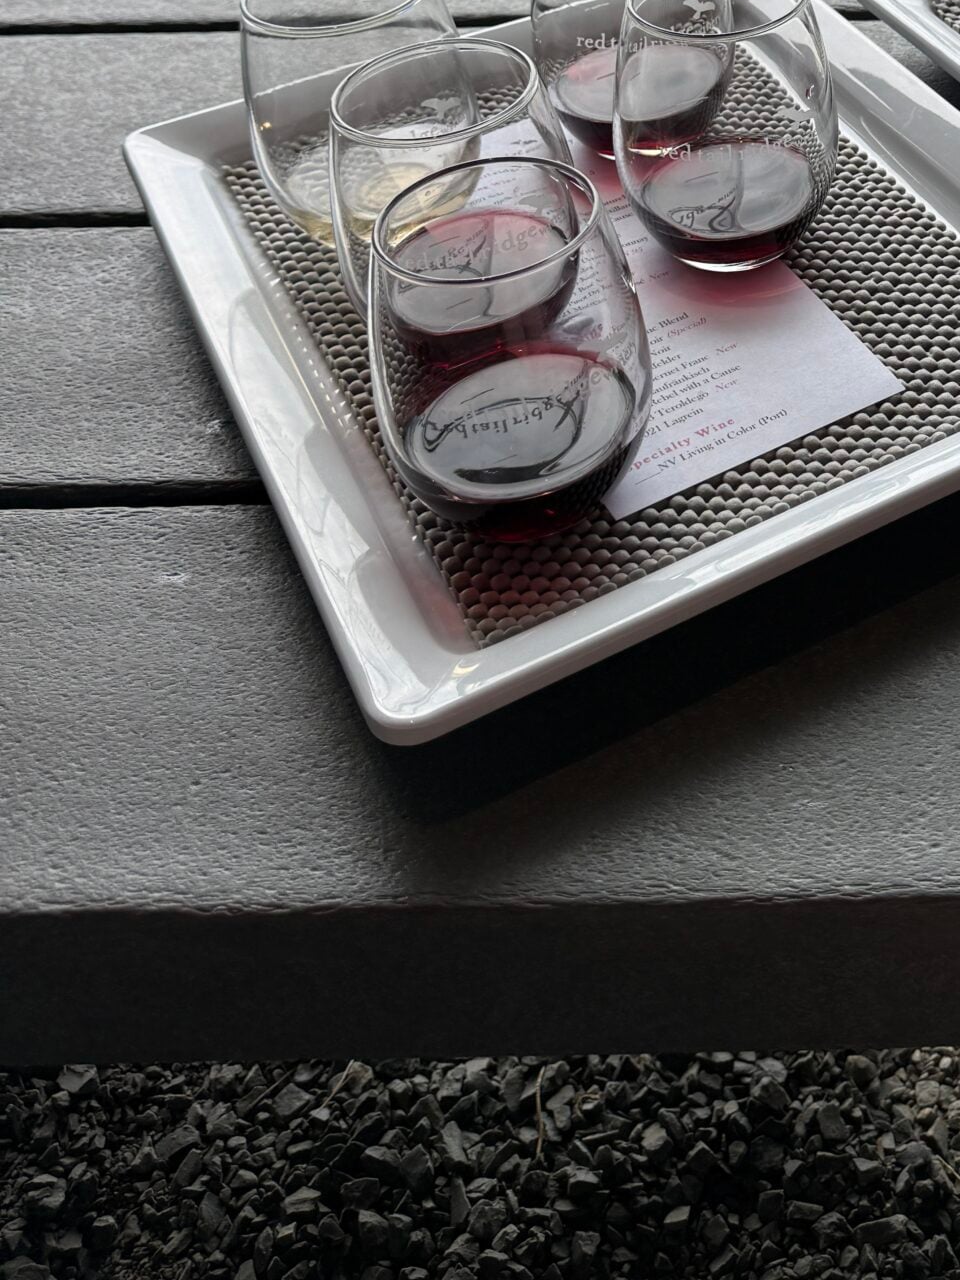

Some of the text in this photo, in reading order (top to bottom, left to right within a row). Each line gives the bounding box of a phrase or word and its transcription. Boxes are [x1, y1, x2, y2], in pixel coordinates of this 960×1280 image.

[576, 33, 606, 49] red
[658, 311, 689, 329] Blend
[667, 316, 707, 338] (Special)
[680, 354, 710, 370] Franc
[715, 341, 738, 356] New
[679, 379, 703, 394] with
[710, 364, 743, 380] Cause
[654, 379, 738, 417] Teroldego New
[663, 407, 704, 428] Lagrein
[694, 417, 736, 439] Wine
[657, 408, 789, 471] NV Living in Color (Port)
